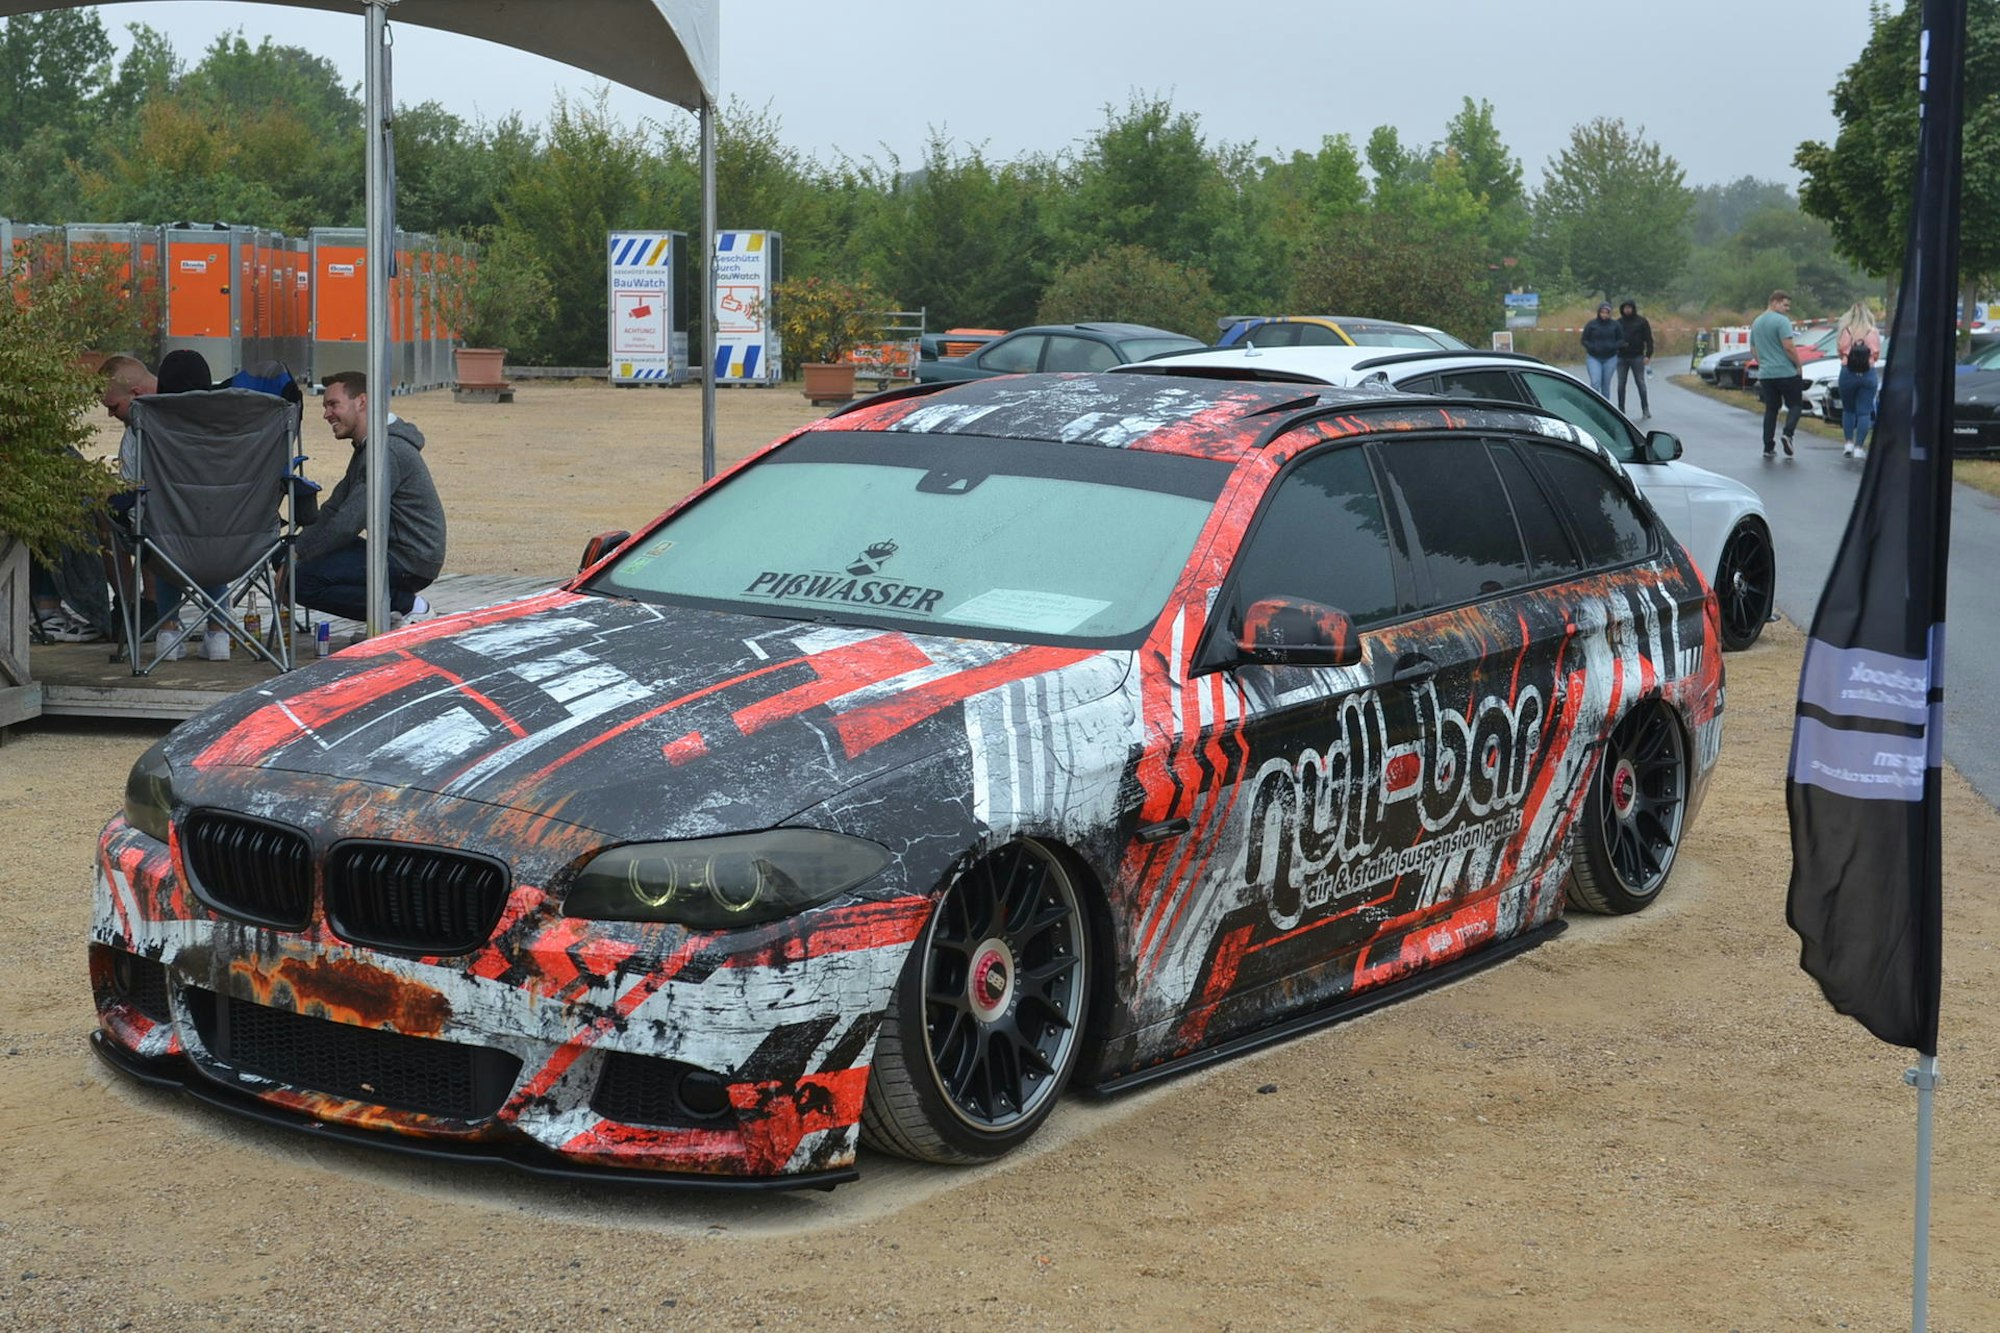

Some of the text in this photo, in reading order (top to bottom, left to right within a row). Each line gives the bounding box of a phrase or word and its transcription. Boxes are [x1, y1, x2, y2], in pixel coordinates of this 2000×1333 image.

[614, 278, 666, 288] BauWatch
[1306, 872, 1333, 901] air
[1399, 823, 1481, 873] suspension
